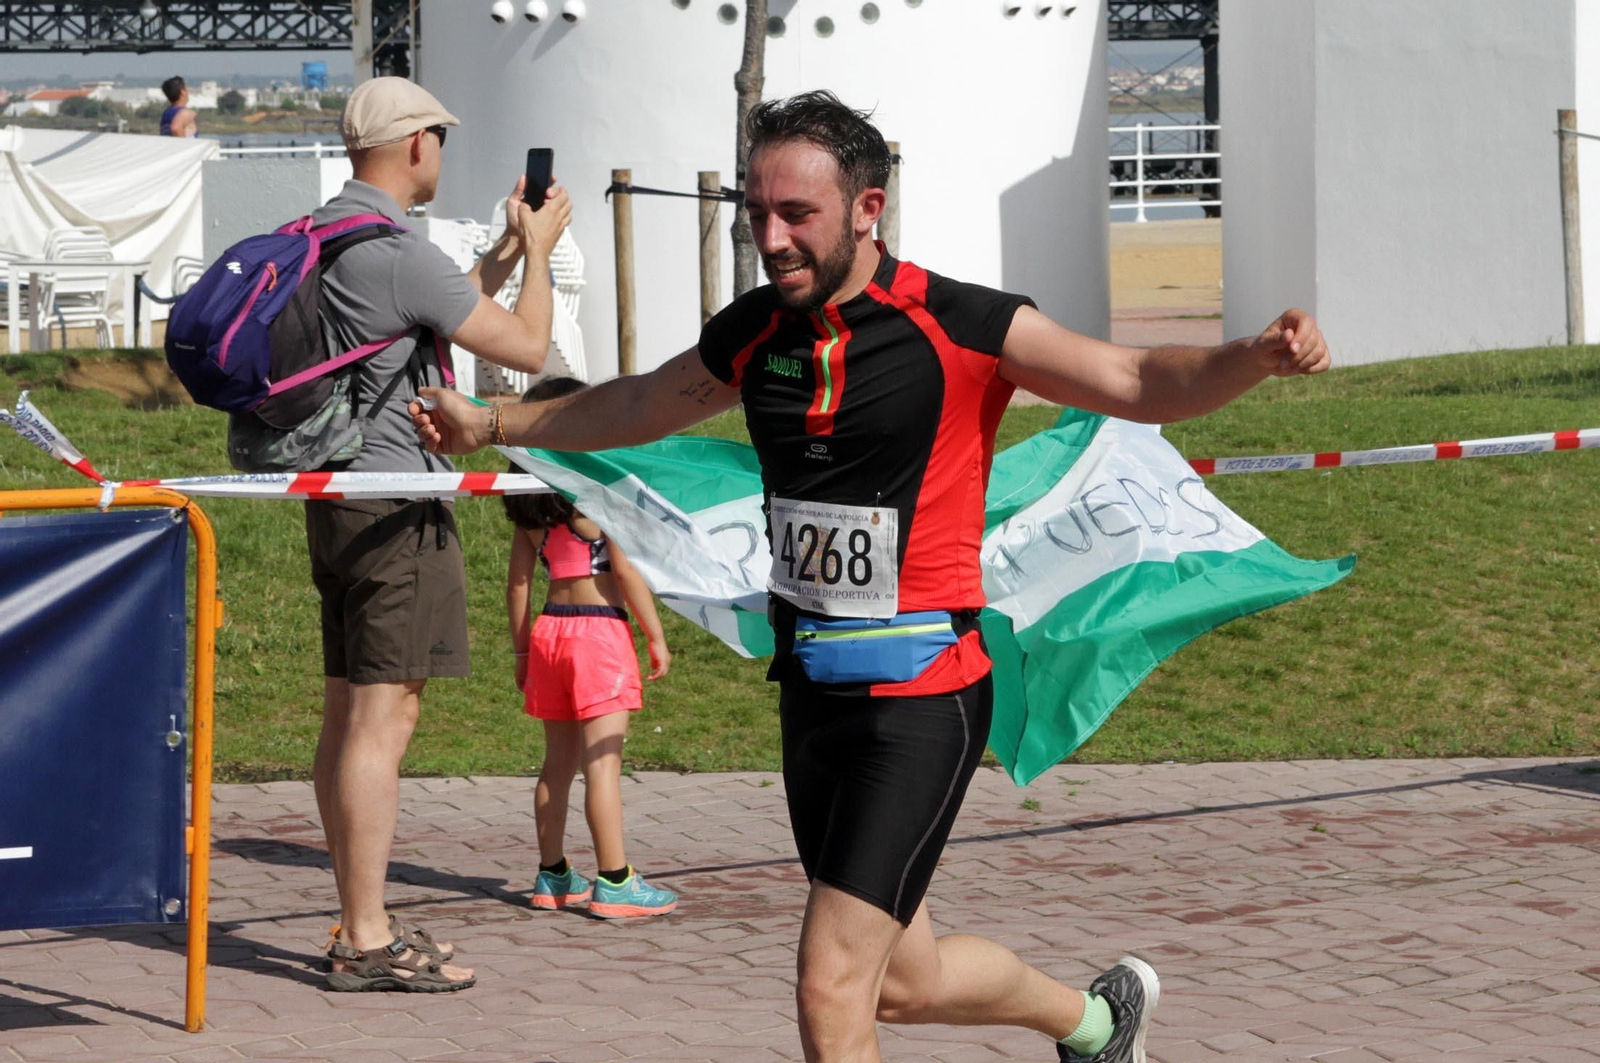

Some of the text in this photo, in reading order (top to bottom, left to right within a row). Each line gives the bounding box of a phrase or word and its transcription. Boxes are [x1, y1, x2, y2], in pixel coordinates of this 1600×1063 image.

[764, 354, 802, 378] SAMUEL
[781, 522, 872, 586] 4268
[822, 588, 880, 600] DEPORTIVA
